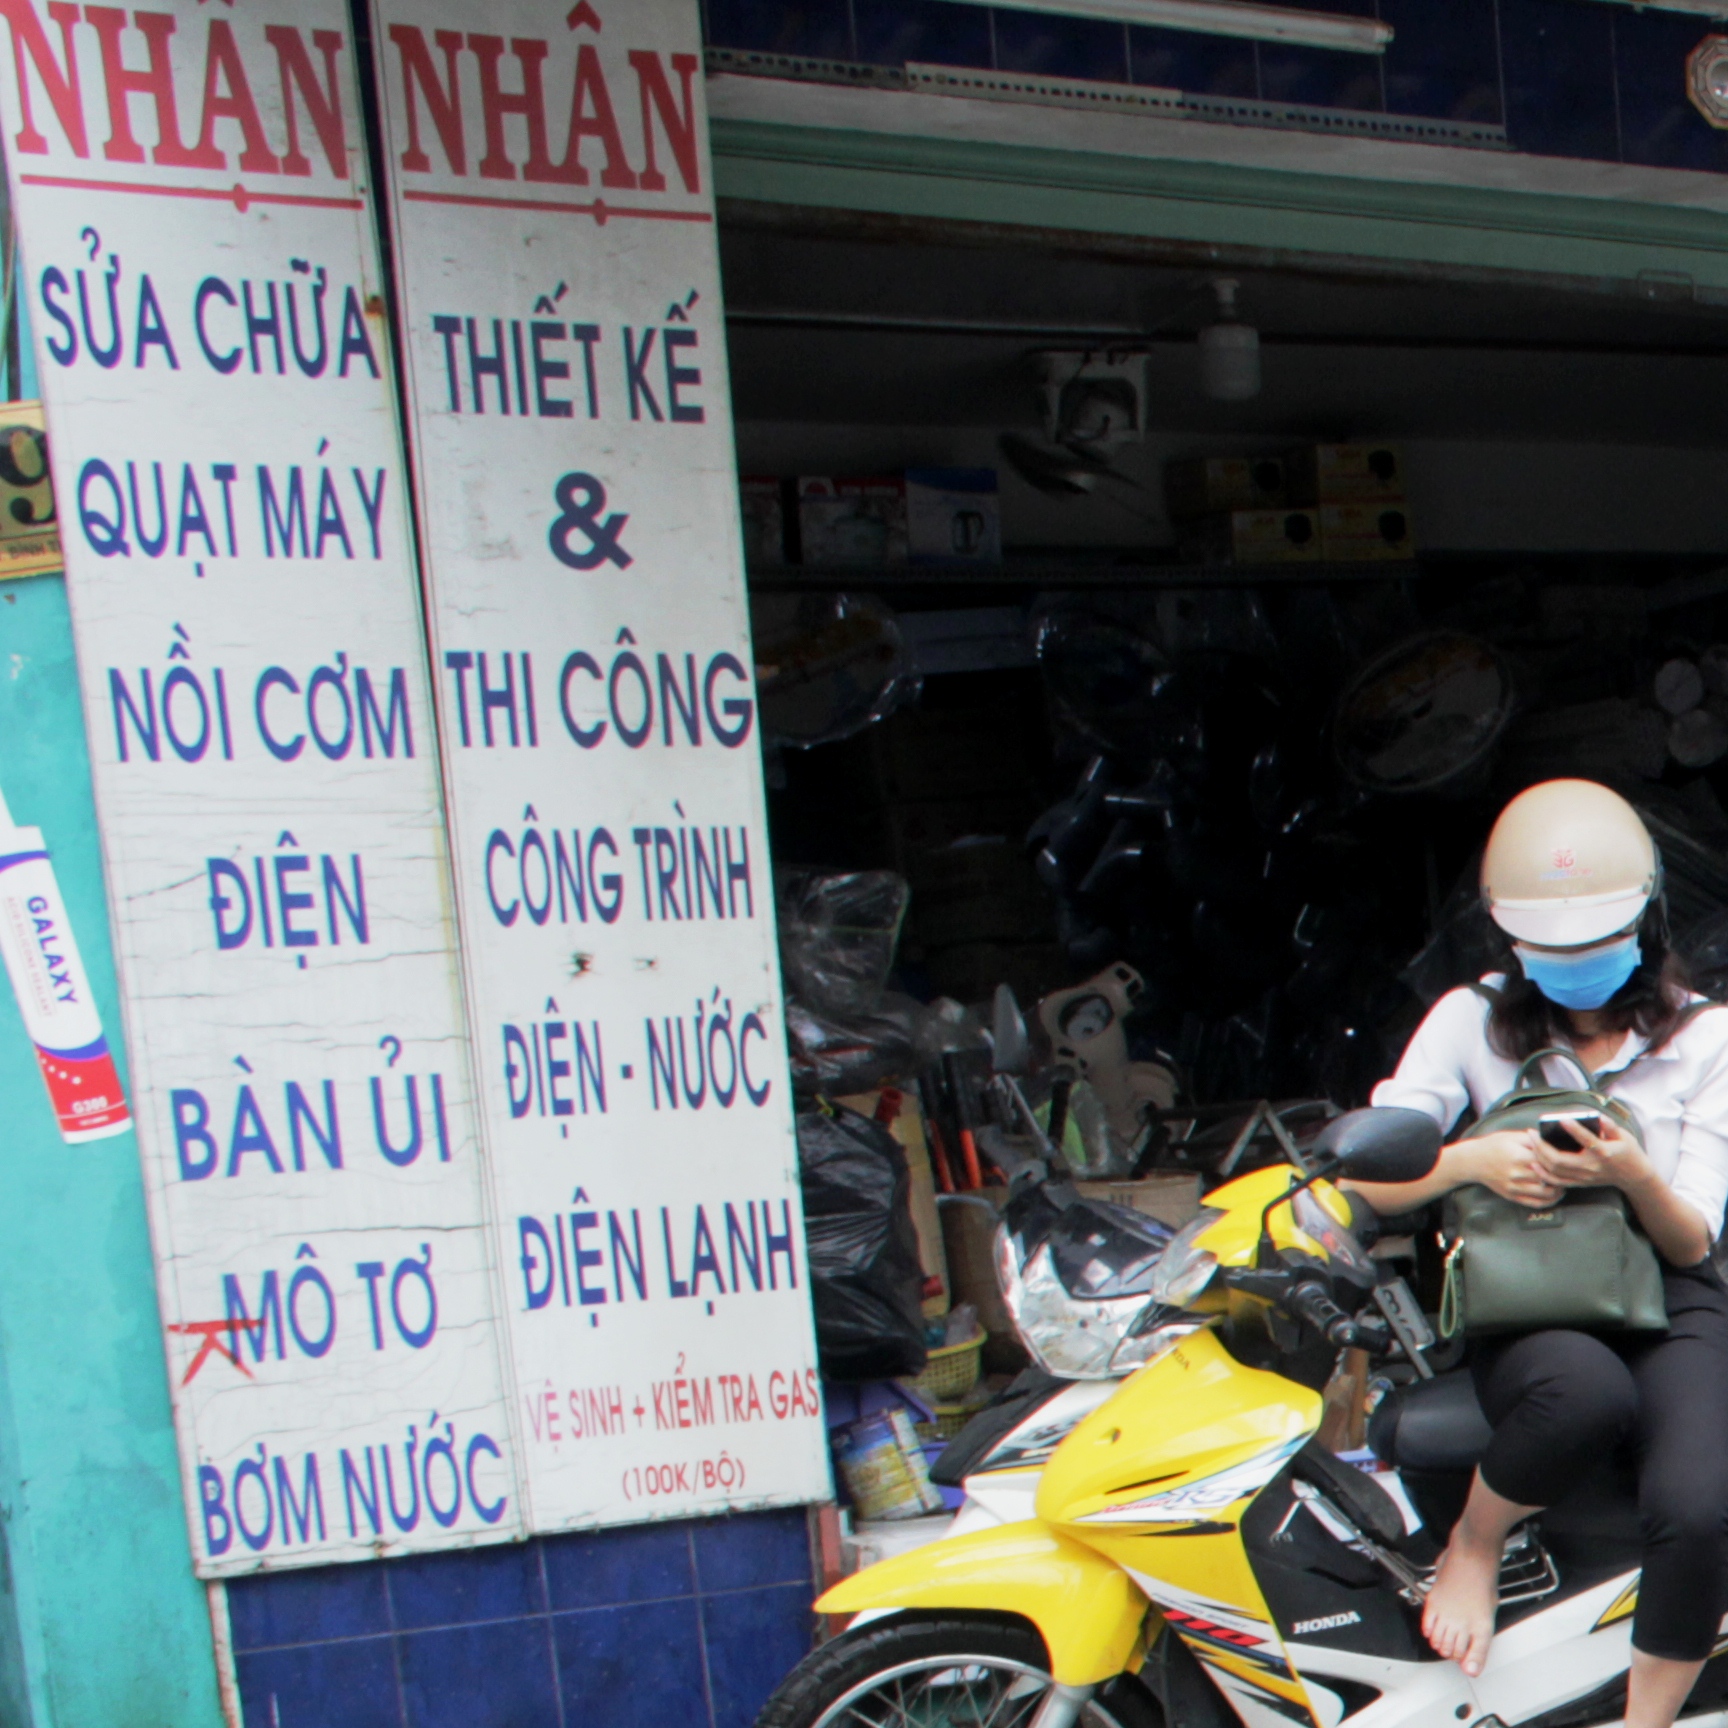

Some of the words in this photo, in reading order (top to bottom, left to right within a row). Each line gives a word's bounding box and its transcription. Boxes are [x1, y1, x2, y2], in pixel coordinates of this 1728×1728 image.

[390, 1, 701, 194] NHÂN
[40, 226, 180, 371] SỬA
[194, 258, 381, 380] CHỮA
[433, 281, 602, 419] THIẾT
[623, 289, 706, 424] KẾ
[77, 458, 239, 578] QUẠT
[256, 438, 387, 560] MÁY
[549, 471, 634, 571] &
[107, 622, 234, 763] NỒI
[254, 652, 416, 761] CƠM
[446, 649, 540, 749] THI
[559, 627, 754, 750] CÔNG
[206, 829, 371, 969] ĐIỆN
[485, 804, 624, 928] CÔNG
[633, 801, 756, 924] TRÌNH
[27, 895, 79, 1004] GALAXY
[171, 1054, 345, 1182] BÀN
[372, 1035, 452, 1168] ỦI
[501, 997, 607, 1139] ĐIỆN
[646, 985, 772, 1111] NƯỚC
[222, 1241, 338, 1364] MÔ
[356, 1243, 438, 1352] TƠ
[518, 1187, 648, 1328] ĐIỆN
[665, 1199, 799, 1317] LẠNH
[526, 1378, 562, 1453] VỆ
[569, 1386, 625, 1439] SINH
[652, 1351, 715, 1431] KIỂM
[718, 1373, 764, 1423] TRA
[769, 1368, 820, 1420] GAS
[198, 1440, 326, 1558] BƠM
[340, 1410, 508, 1534] NƯỚC
[622, 1450, 745, 1501] (100K/BỘ)
[1292, 1610, 1362, 1635] HONDA
